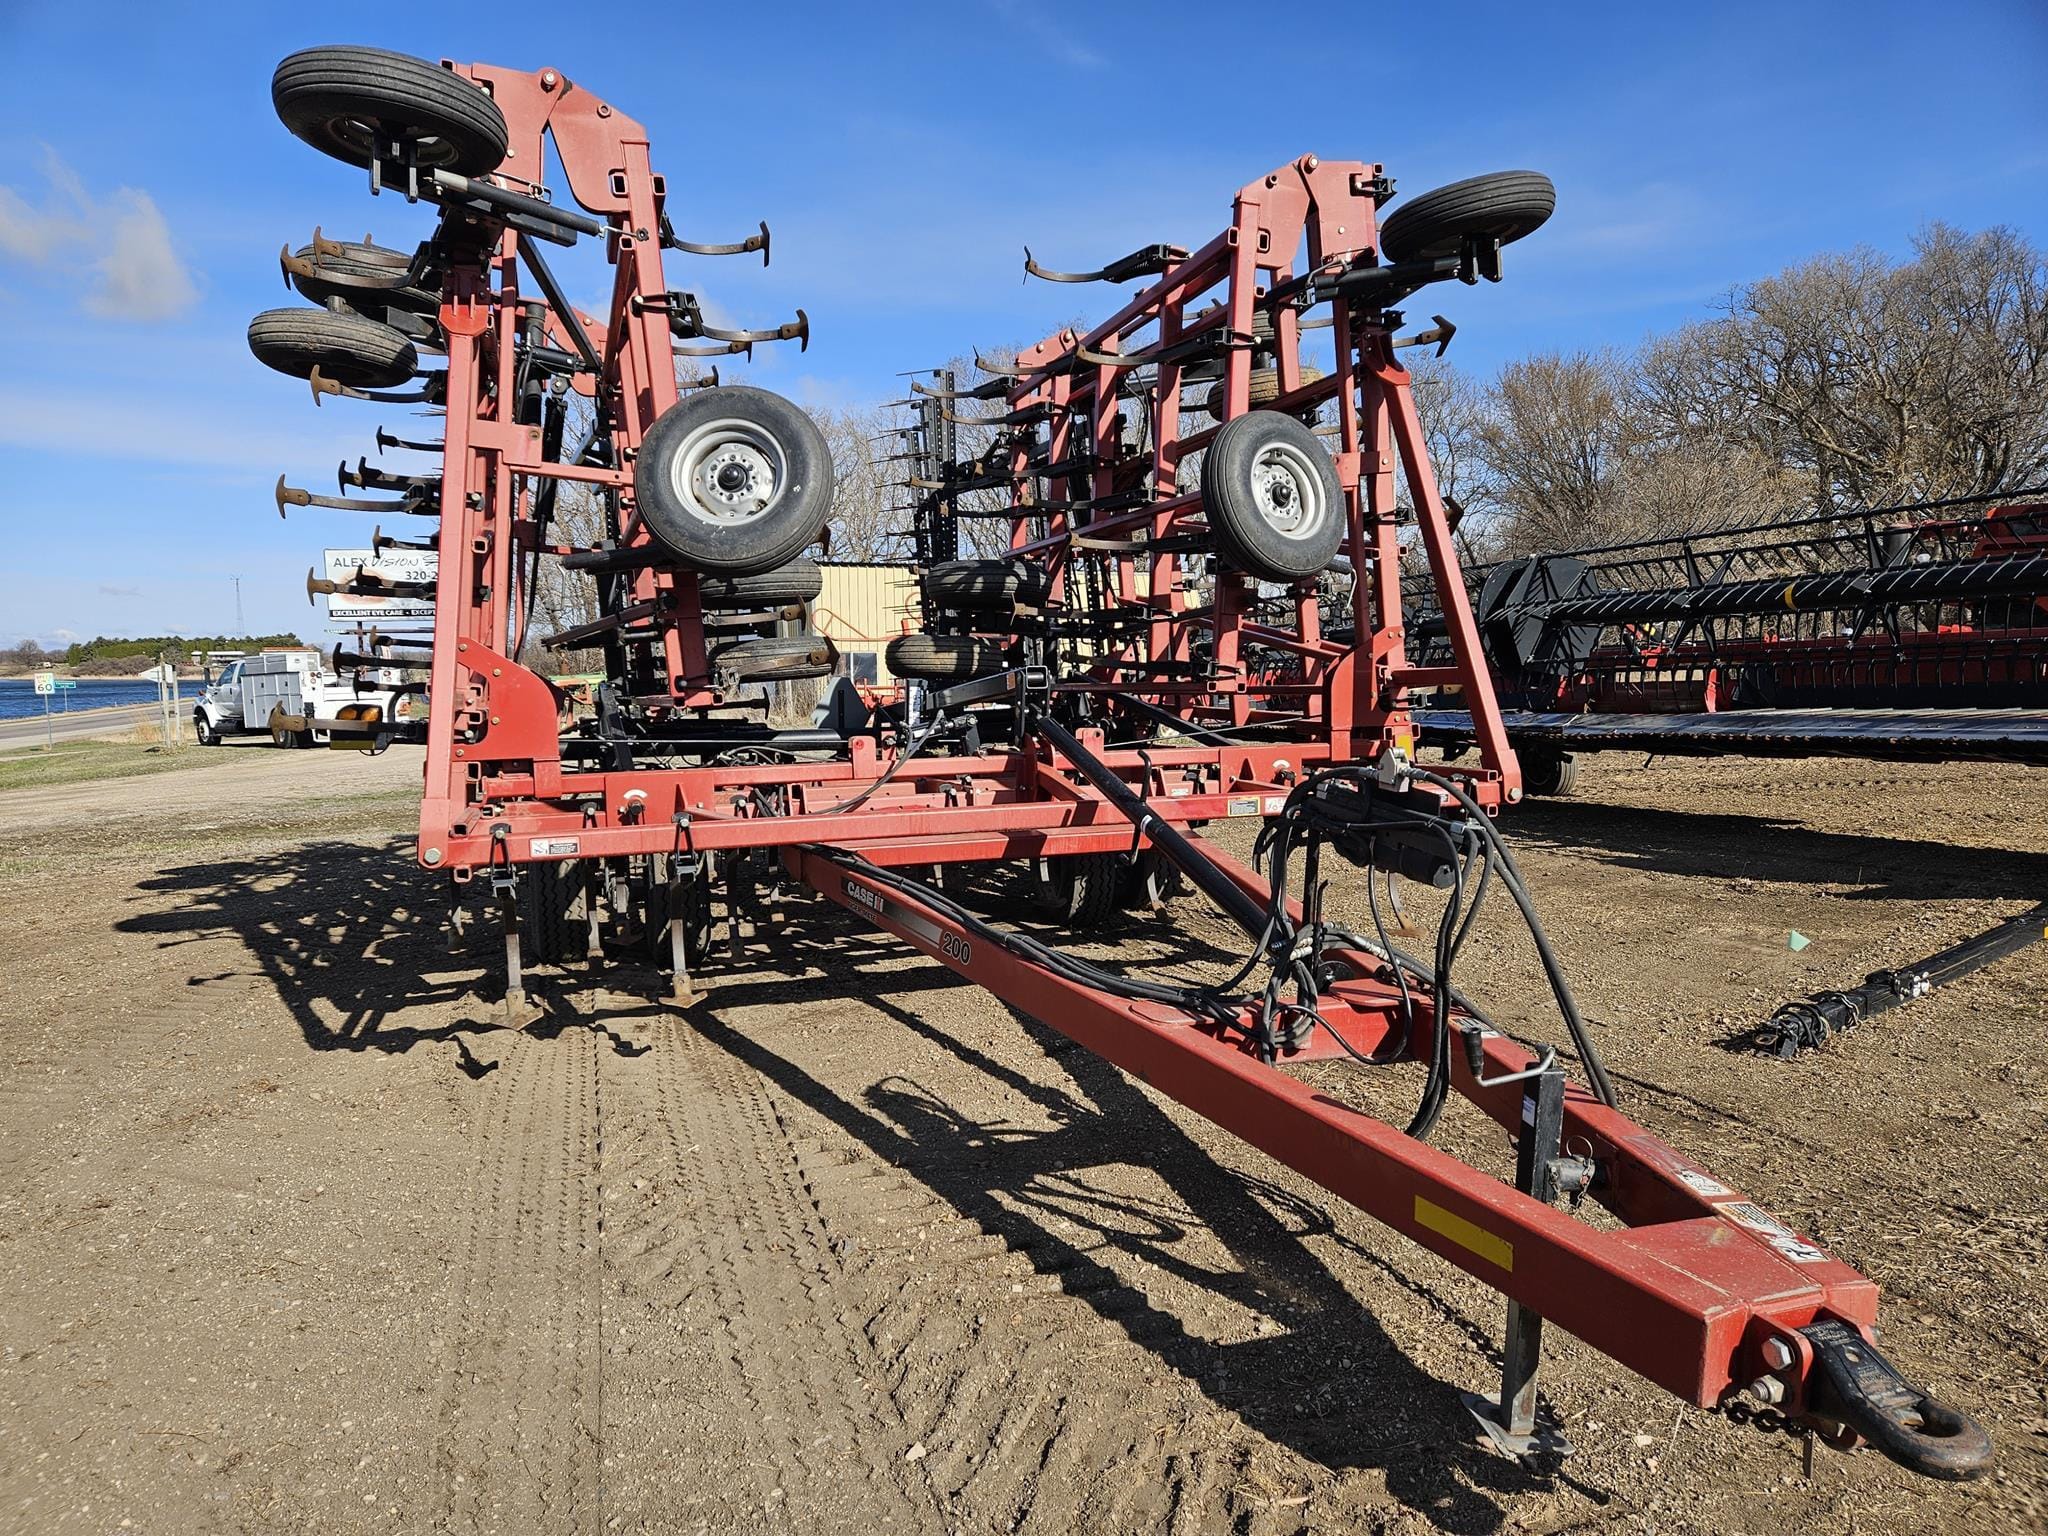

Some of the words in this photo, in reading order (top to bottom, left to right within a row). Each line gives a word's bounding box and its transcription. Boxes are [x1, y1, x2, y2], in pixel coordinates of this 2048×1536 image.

[333, 557, 368, 567] ALEX
[37, 683, 52, 691] 60
[847, 881, 874, 907] CASE
[942, 931, 972, 966] 200
